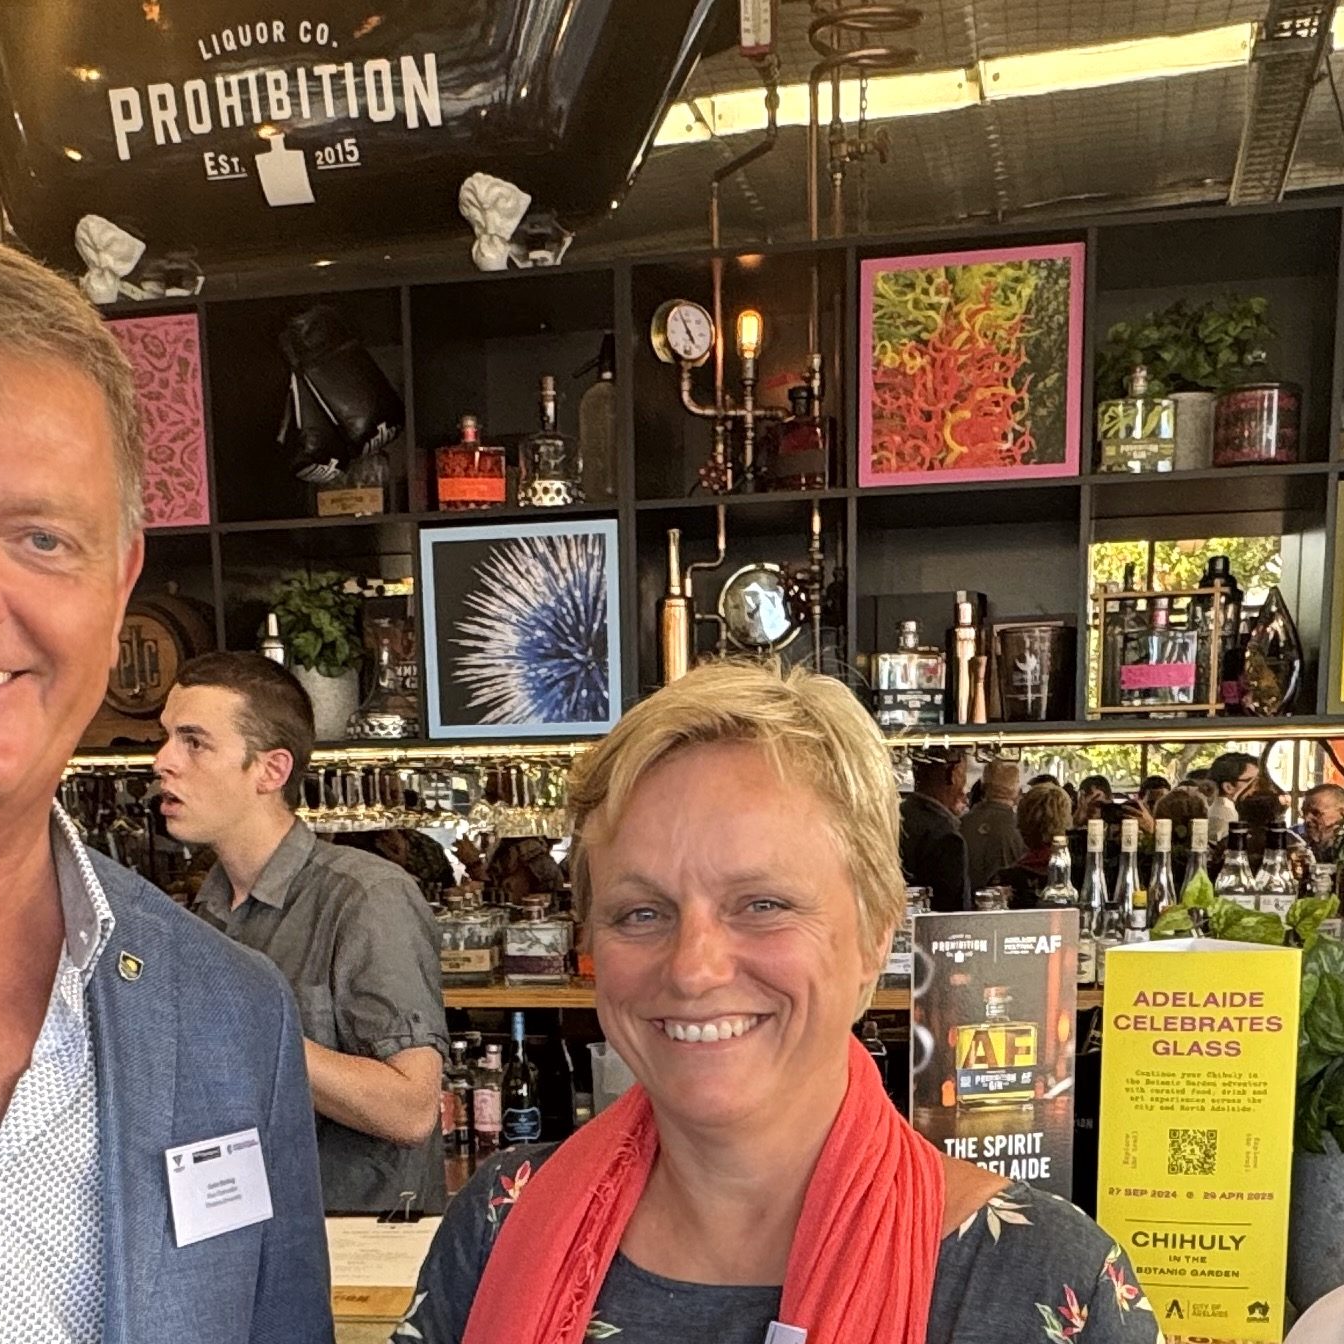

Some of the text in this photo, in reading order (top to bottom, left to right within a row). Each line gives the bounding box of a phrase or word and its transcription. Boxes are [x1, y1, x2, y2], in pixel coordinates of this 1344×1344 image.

[198, 20, 339, 60] LIQUOR CO.
[108, 52, 444, 161] PROHIBITION
[315, 138, 361, 166] 2015
[932, 939, 988, 955] PROHIBITION
[1035, 935, 1062, 954] AF
[1133, 991, 1264, 1008] ADELAIDE
[1113, 1014, 1283, 1033] CELEBRATES
[962, 1029, 1032, 1069] AF
[1152, 1039, 1242, 1057] GLASS
[1135, 1069, 1176, 1078] Continue
[1181, 1071, 1202, 1080] your
[1206, 1071, 1243, 1081] Chihuly
[1186, 1079, 1217, 1087] Garden
[1222, 1080, 1268, 1088] adventure
[1125, 1086, 1145, 1094] with
[1150, 1087, 1185, 1095] curated
[1222, 1088, 1247, 1096] drink
[1134, 1104, 1154, 1112] city
[1150, 1096, 1205, 1104] experiences
[944, 1132, 1044, 1159] THE SPIRIT
[976, 1157, 1052, 1180] ELAIDE
[1108, 1187, 1274, 1201] 27 SEP 2024 29 APR 2025
[1131, 1231, 1247, 1251] CHIHULY
[1169, 1255, 1207, 1264] IN THE
[1136, 1266, 1240, 1278] BOTANIC GARDEN
